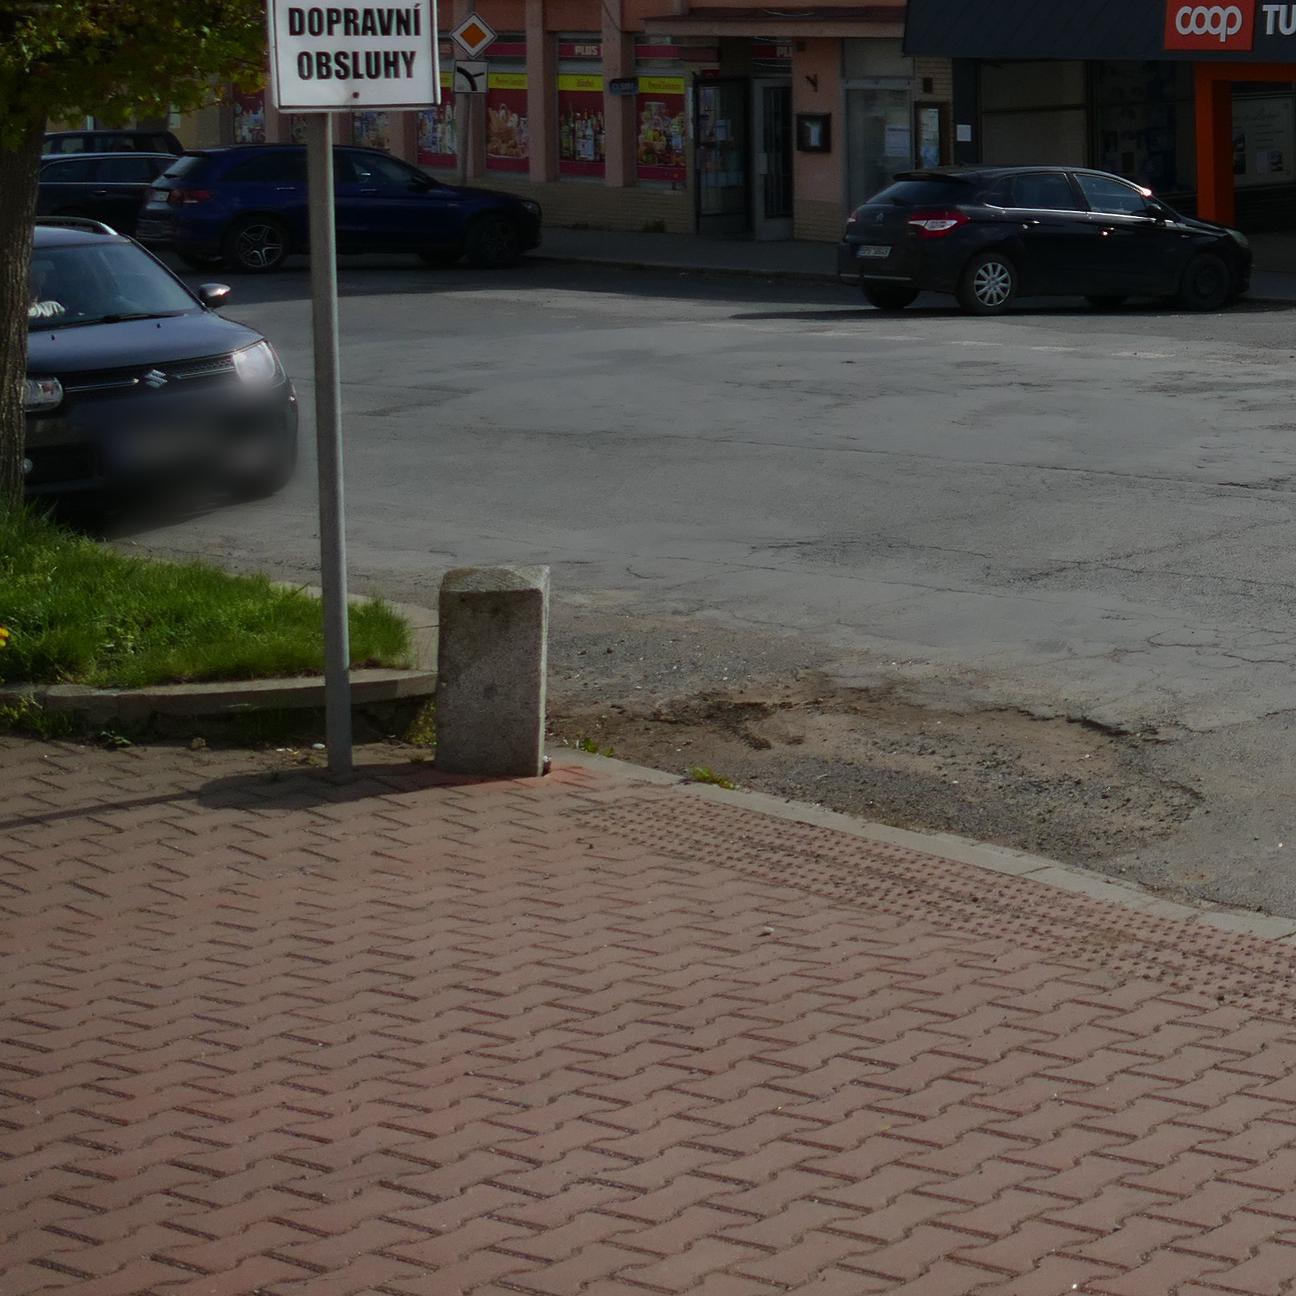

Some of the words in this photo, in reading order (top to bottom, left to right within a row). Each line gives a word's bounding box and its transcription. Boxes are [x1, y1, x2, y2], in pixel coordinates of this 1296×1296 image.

[288, 3, 422, 36] DOPRAVNÍ
[1175, 5, 1243, 43] coop
[297, 51, 416, 80] OBSLUHY
[575, 45, 600, 56] PLUS
